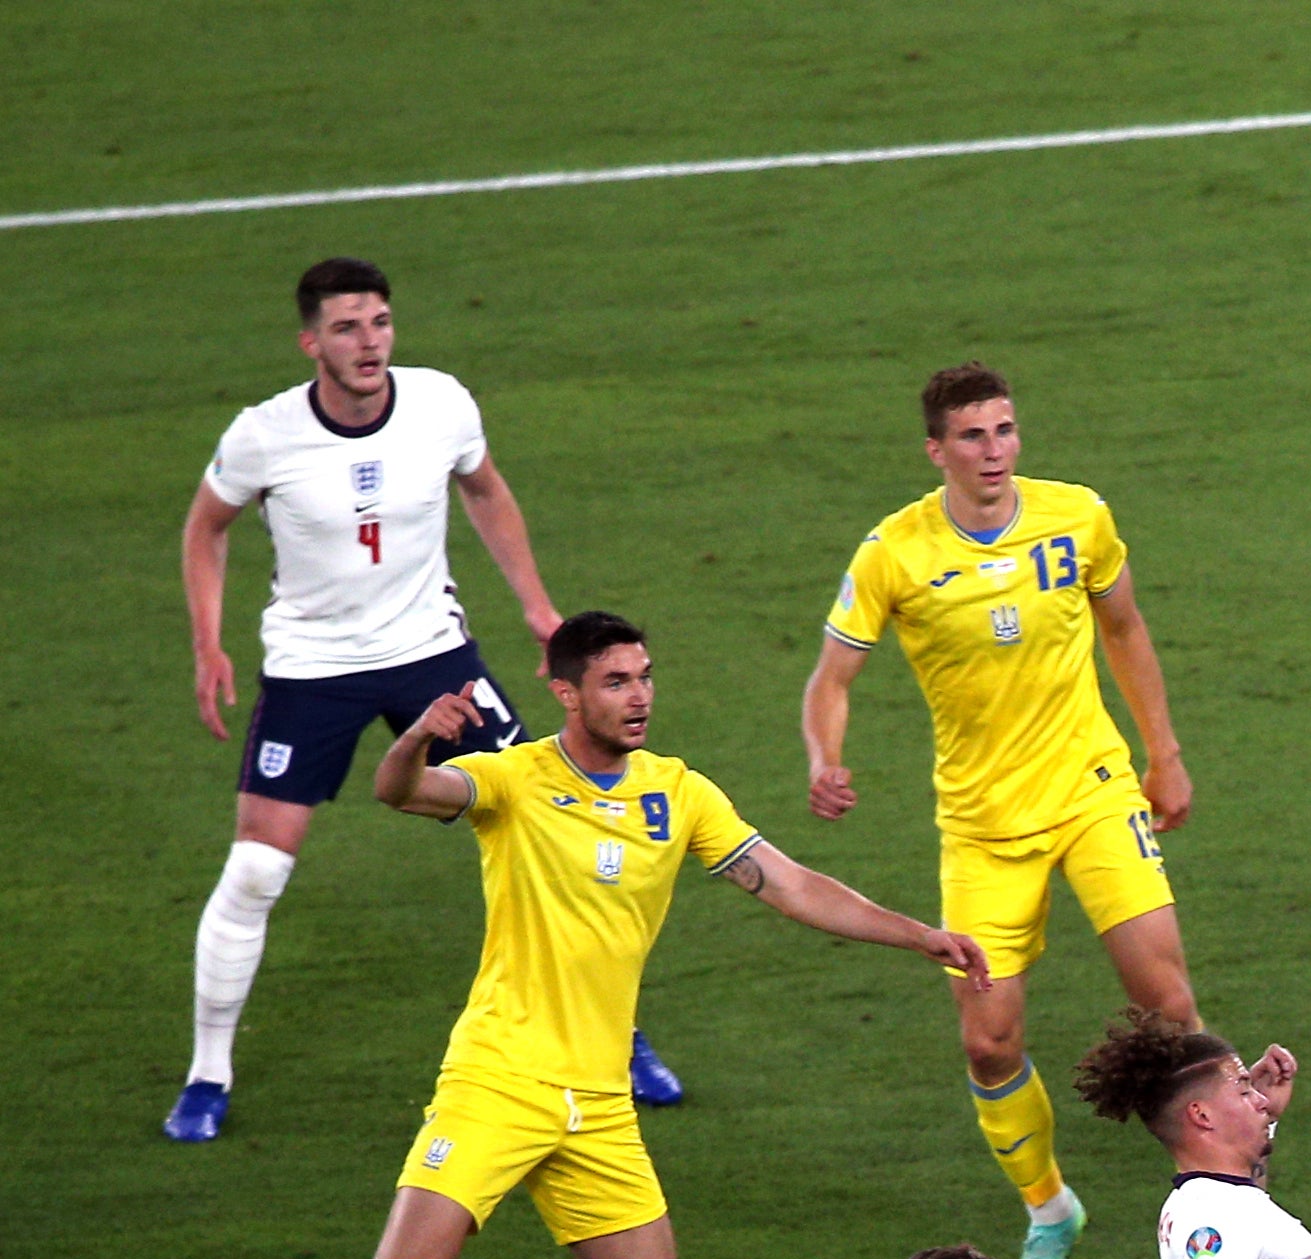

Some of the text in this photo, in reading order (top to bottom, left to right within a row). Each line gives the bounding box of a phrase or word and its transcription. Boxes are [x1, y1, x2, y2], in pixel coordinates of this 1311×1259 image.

[358, 522, 381, 564] 4
[1028, 536, 1080, 591] 13
[640, 791, 670, 841] 9
